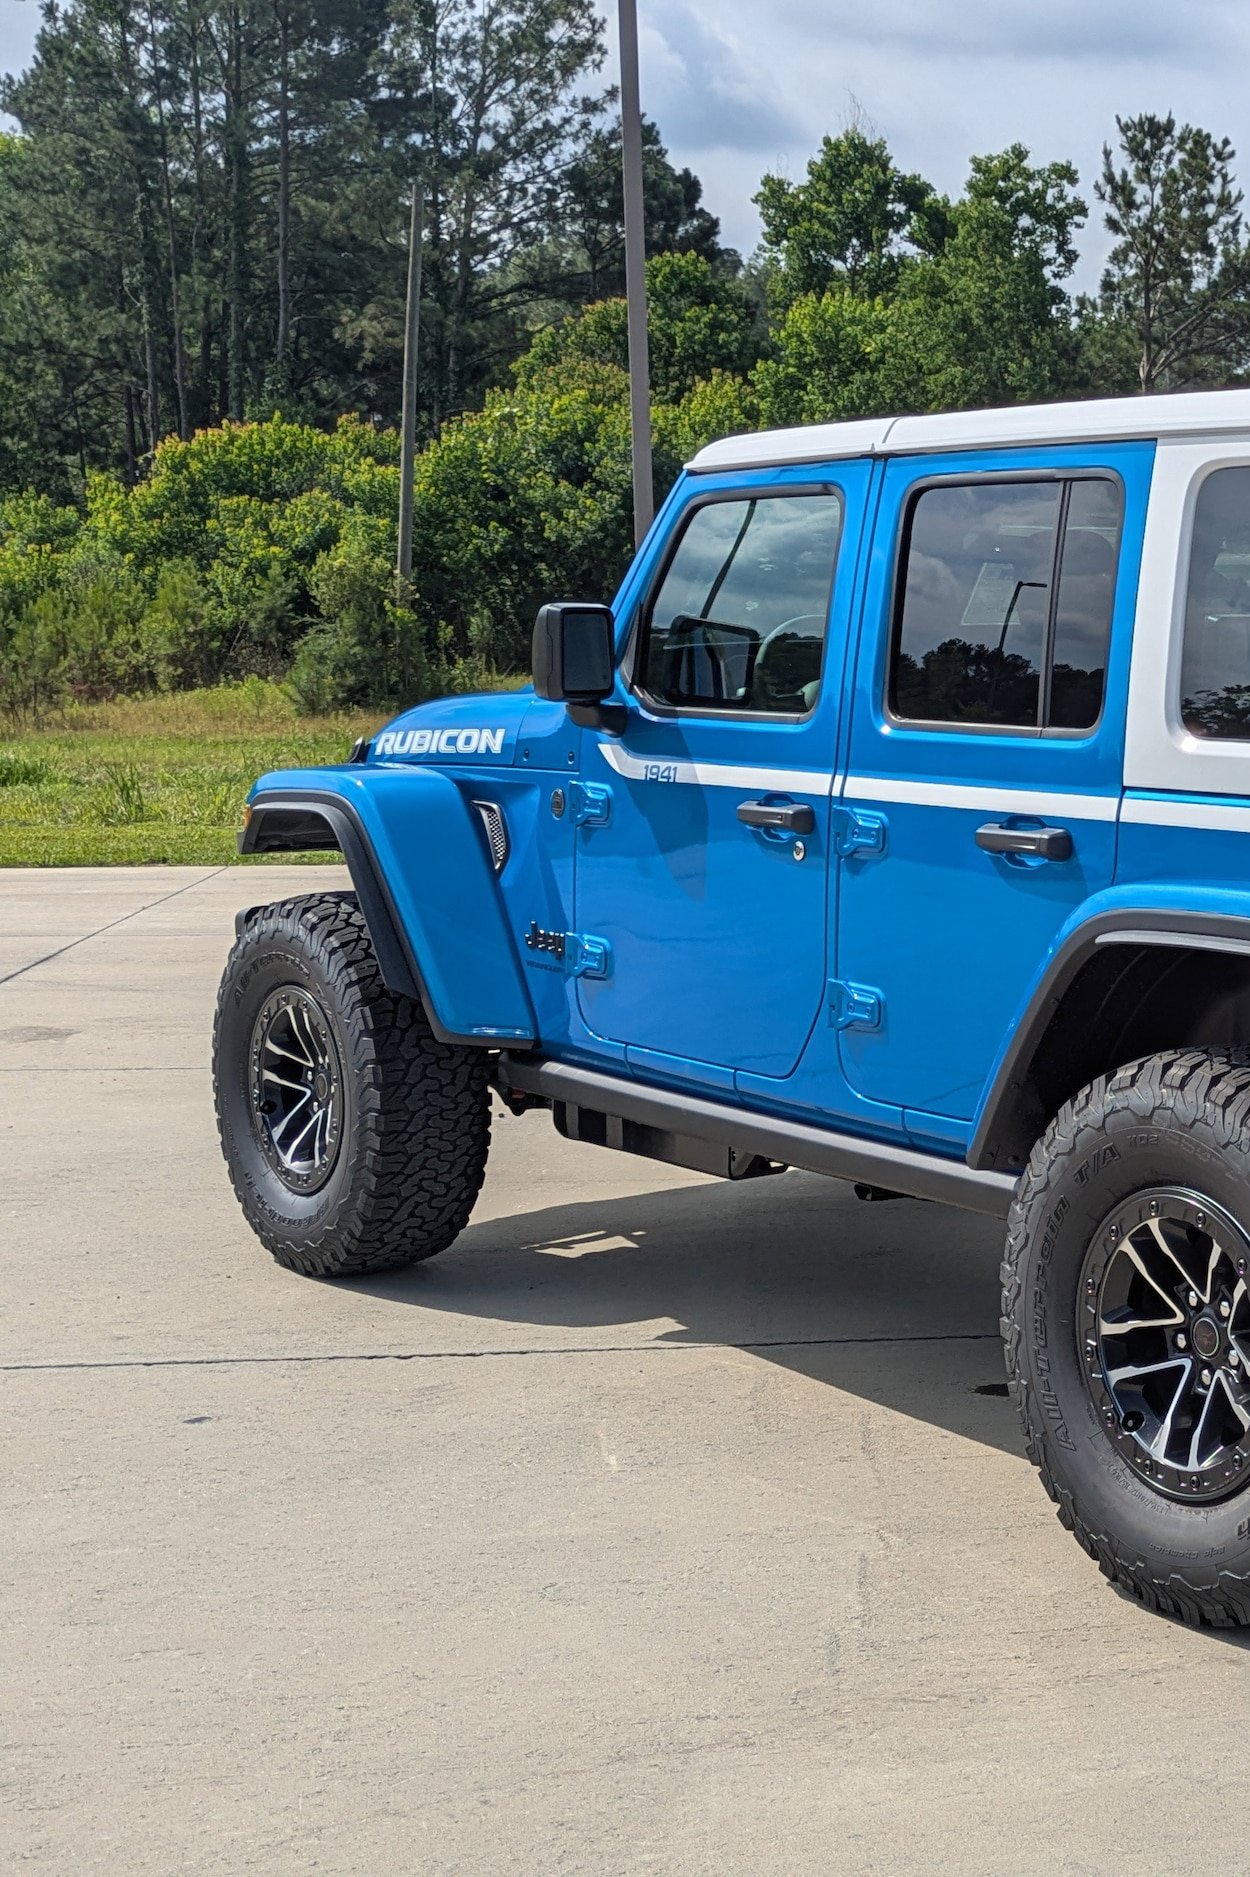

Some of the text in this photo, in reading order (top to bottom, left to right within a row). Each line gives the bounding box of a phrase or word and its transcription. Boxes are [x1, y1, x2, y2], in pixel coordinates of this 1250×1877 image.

[375, 728, 505, 756] RUBICON
[643, 764, 679, 783] 1941
[1032, 1194, 1077, 1453] All-Terrain
[1072, 1141, 1122, 1188] T/A
